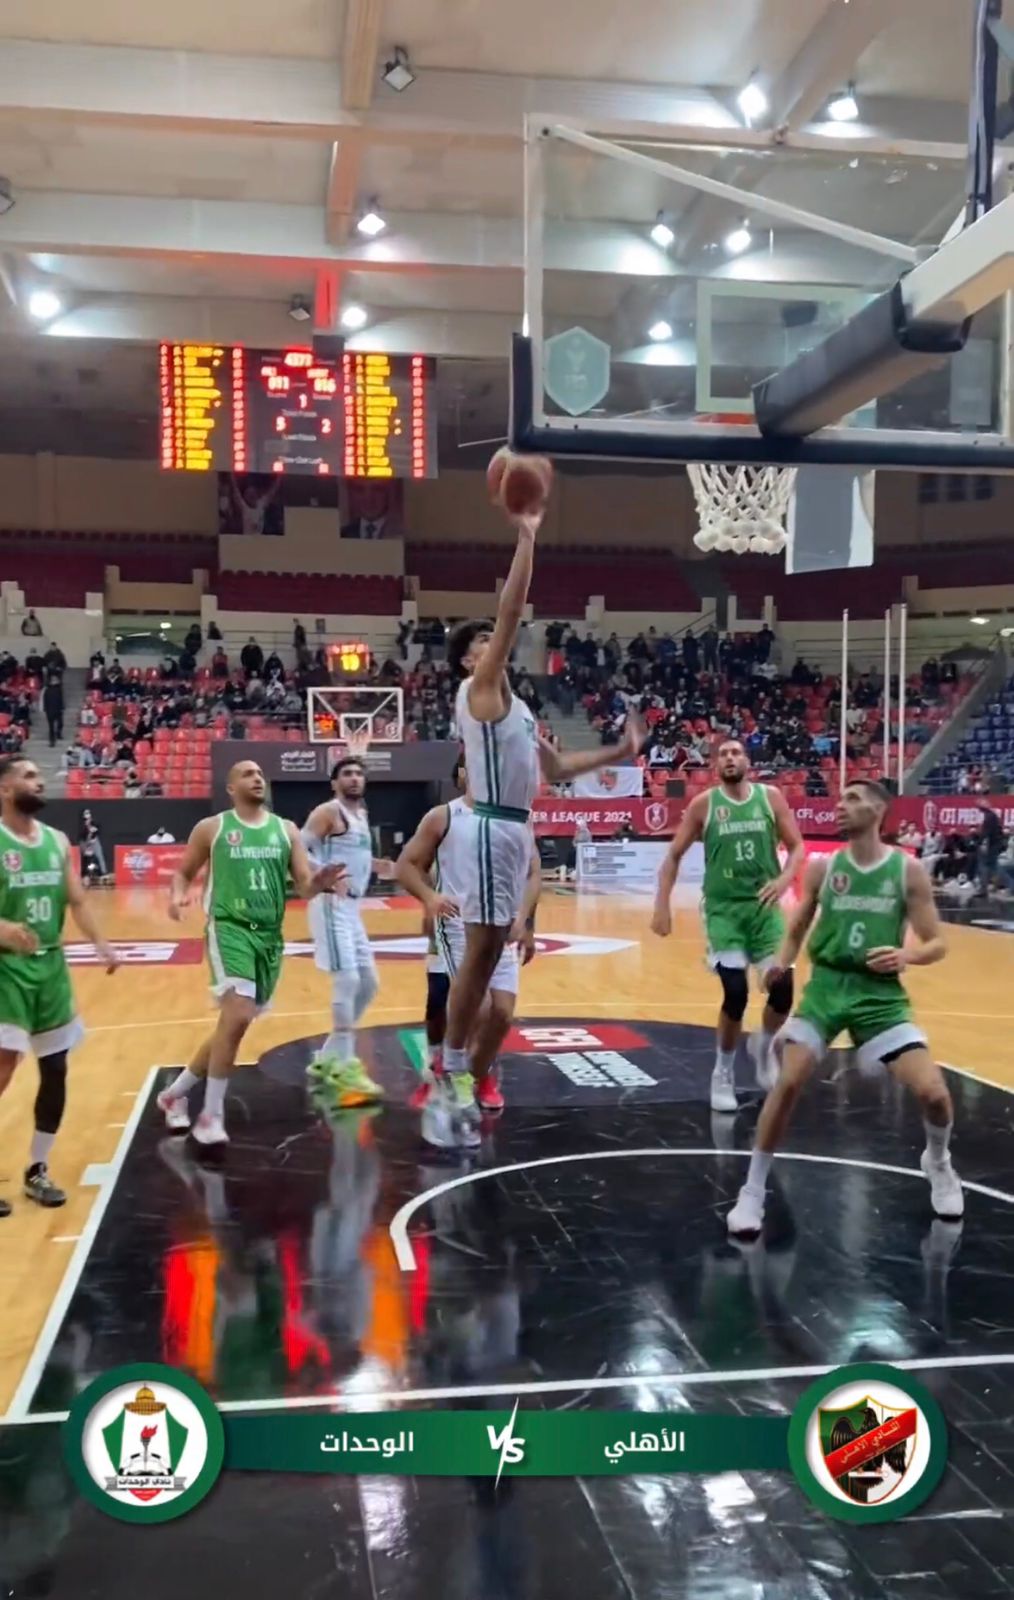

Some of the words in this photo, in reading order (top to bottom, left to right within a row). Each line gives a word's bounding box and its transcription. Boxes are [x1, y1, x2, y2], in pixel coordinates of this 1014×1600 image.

[321, 418, 331, 433] 2
[552, 811, 600, 823] LEAGUE
[735, 840, 755, 861] 13
[249, 867, 268, 891] 11
[26, 896, 52, 923] 30
[848, 921, 866, 948] 6
